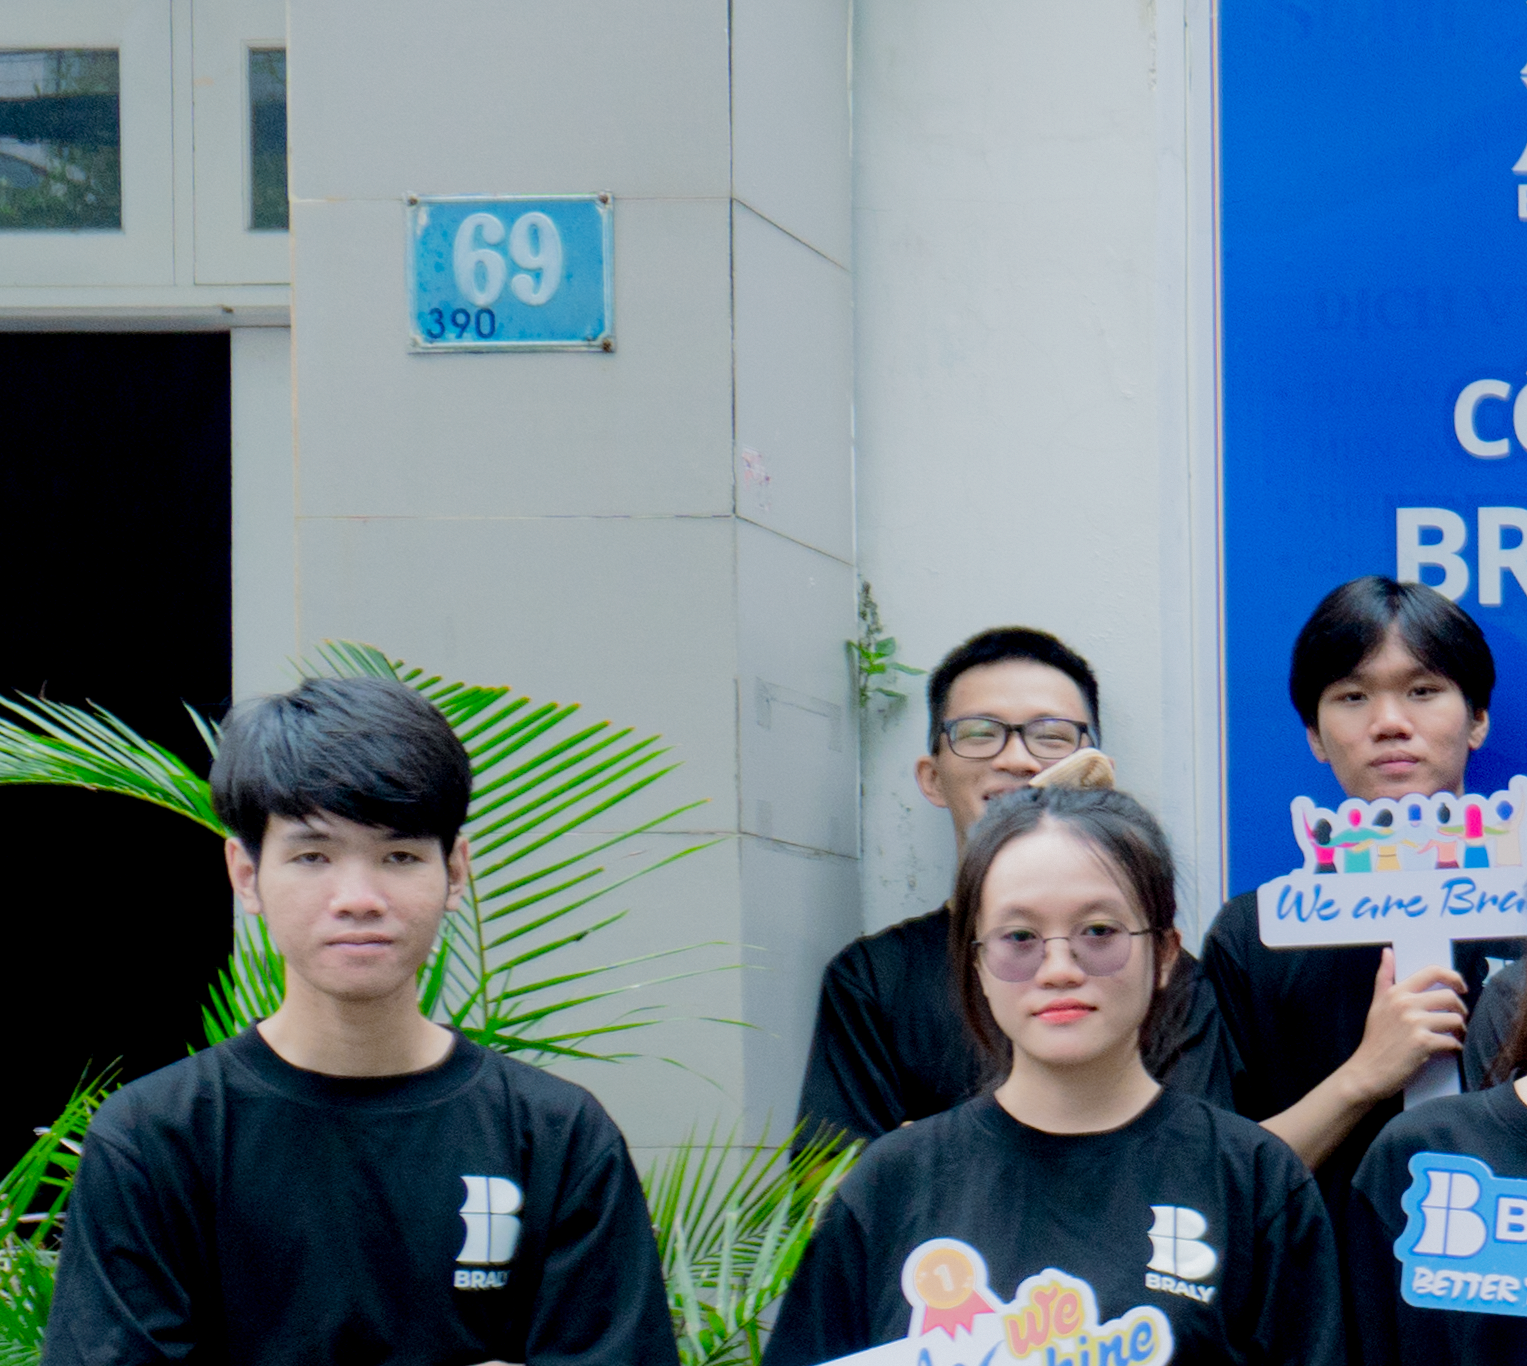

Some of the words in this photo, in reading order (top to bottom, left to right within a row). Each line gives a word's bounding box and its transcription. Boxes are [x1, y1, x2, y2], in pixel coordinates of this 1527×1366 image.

[453, 212, 562, 306] 69
[426, 308, 496, 339] 390
[1276, 882, 1342, 923] We
[1352, 892, 1430, 921] are
[1145, 1272, 1216, 1303] BRALY
[1412, 1267, 1517, 1302] BETTER
